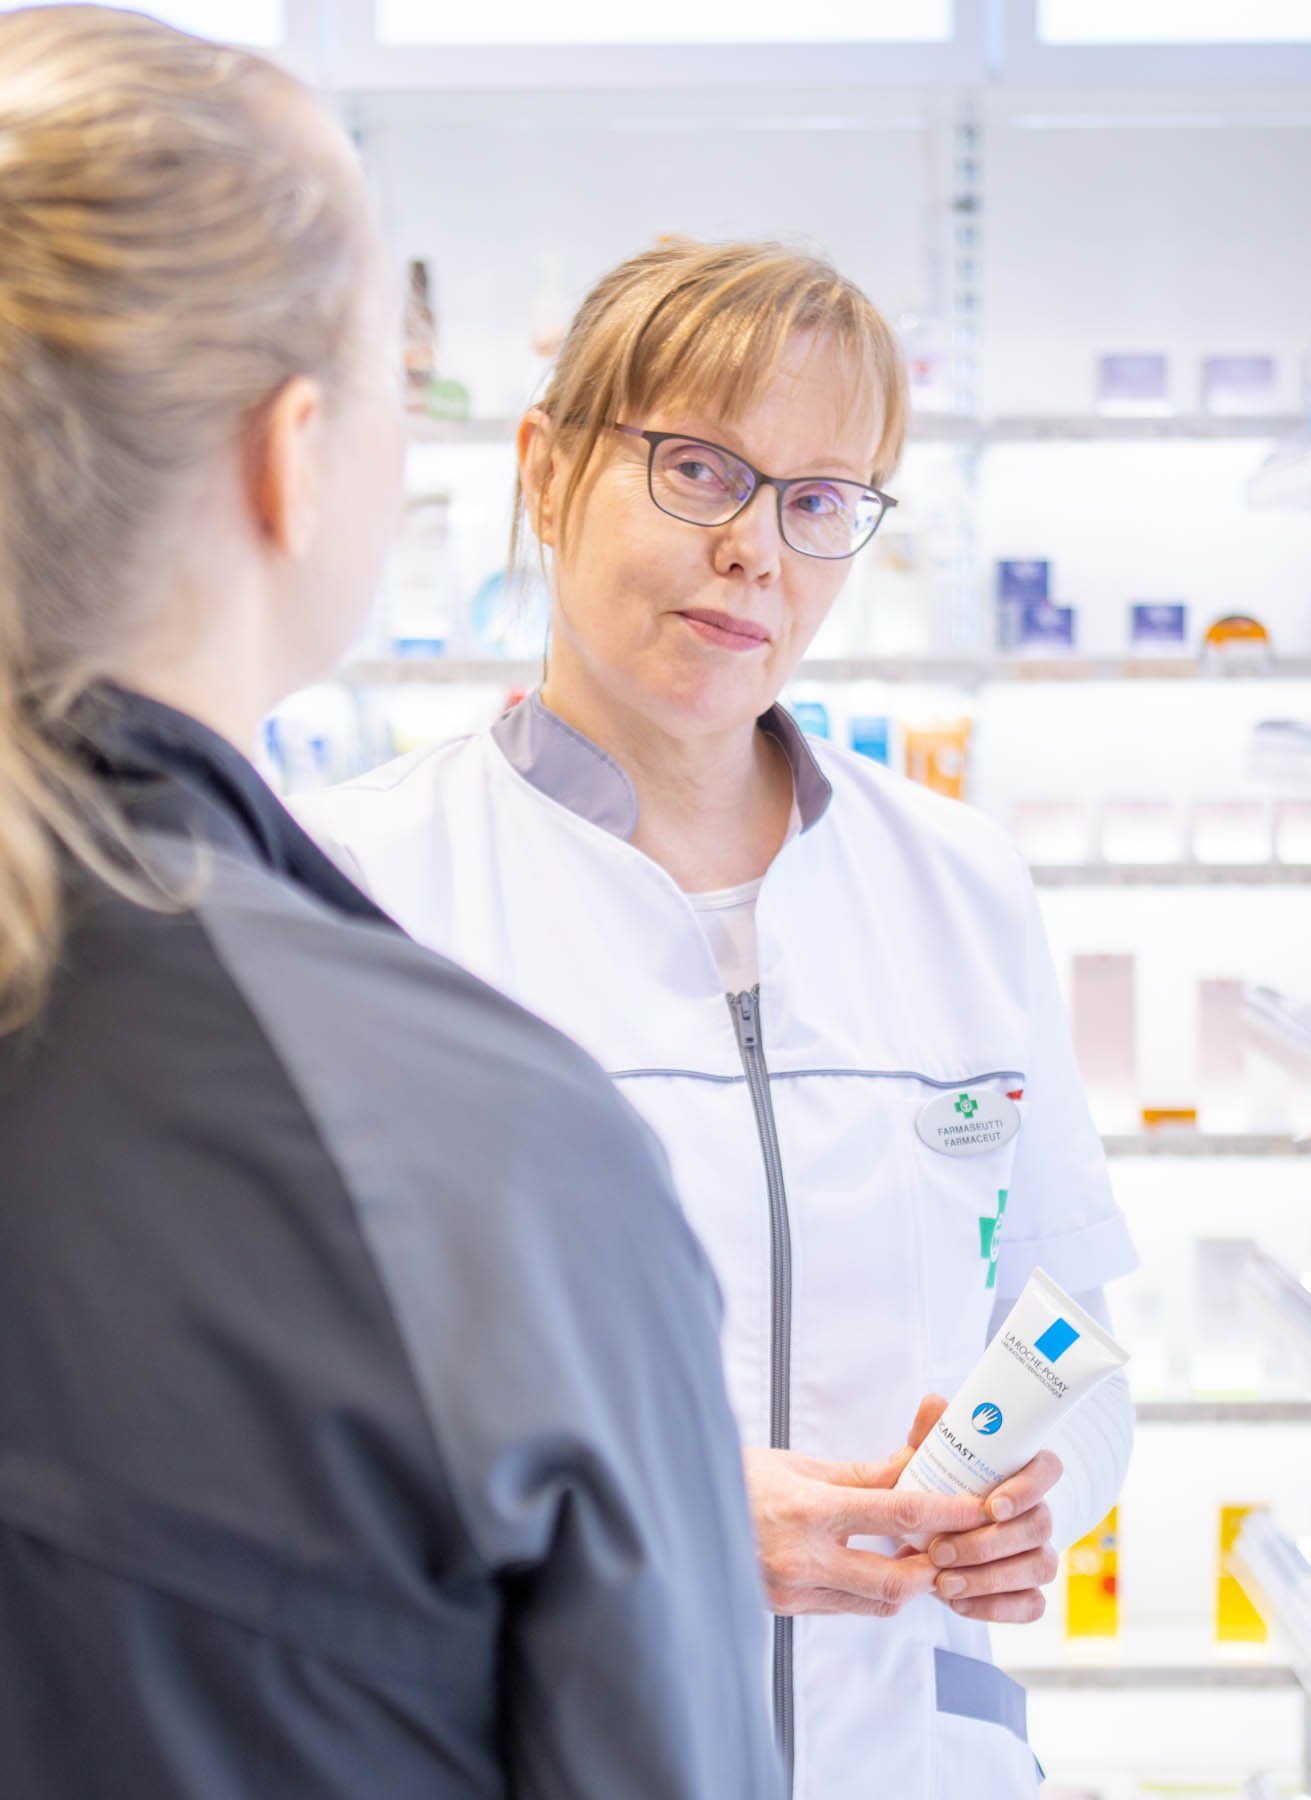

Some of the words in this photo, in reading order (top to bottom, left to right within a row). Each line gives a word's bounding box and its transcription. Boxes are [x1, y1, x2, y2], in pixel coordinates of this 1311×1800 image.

[937, 1119, 1004, 1137] FARMASEUTTI
[944, 1132, 1001, 1148] FARMACEUT
[1014, 1340, 1070, 1393] ROCHE-POSAY
